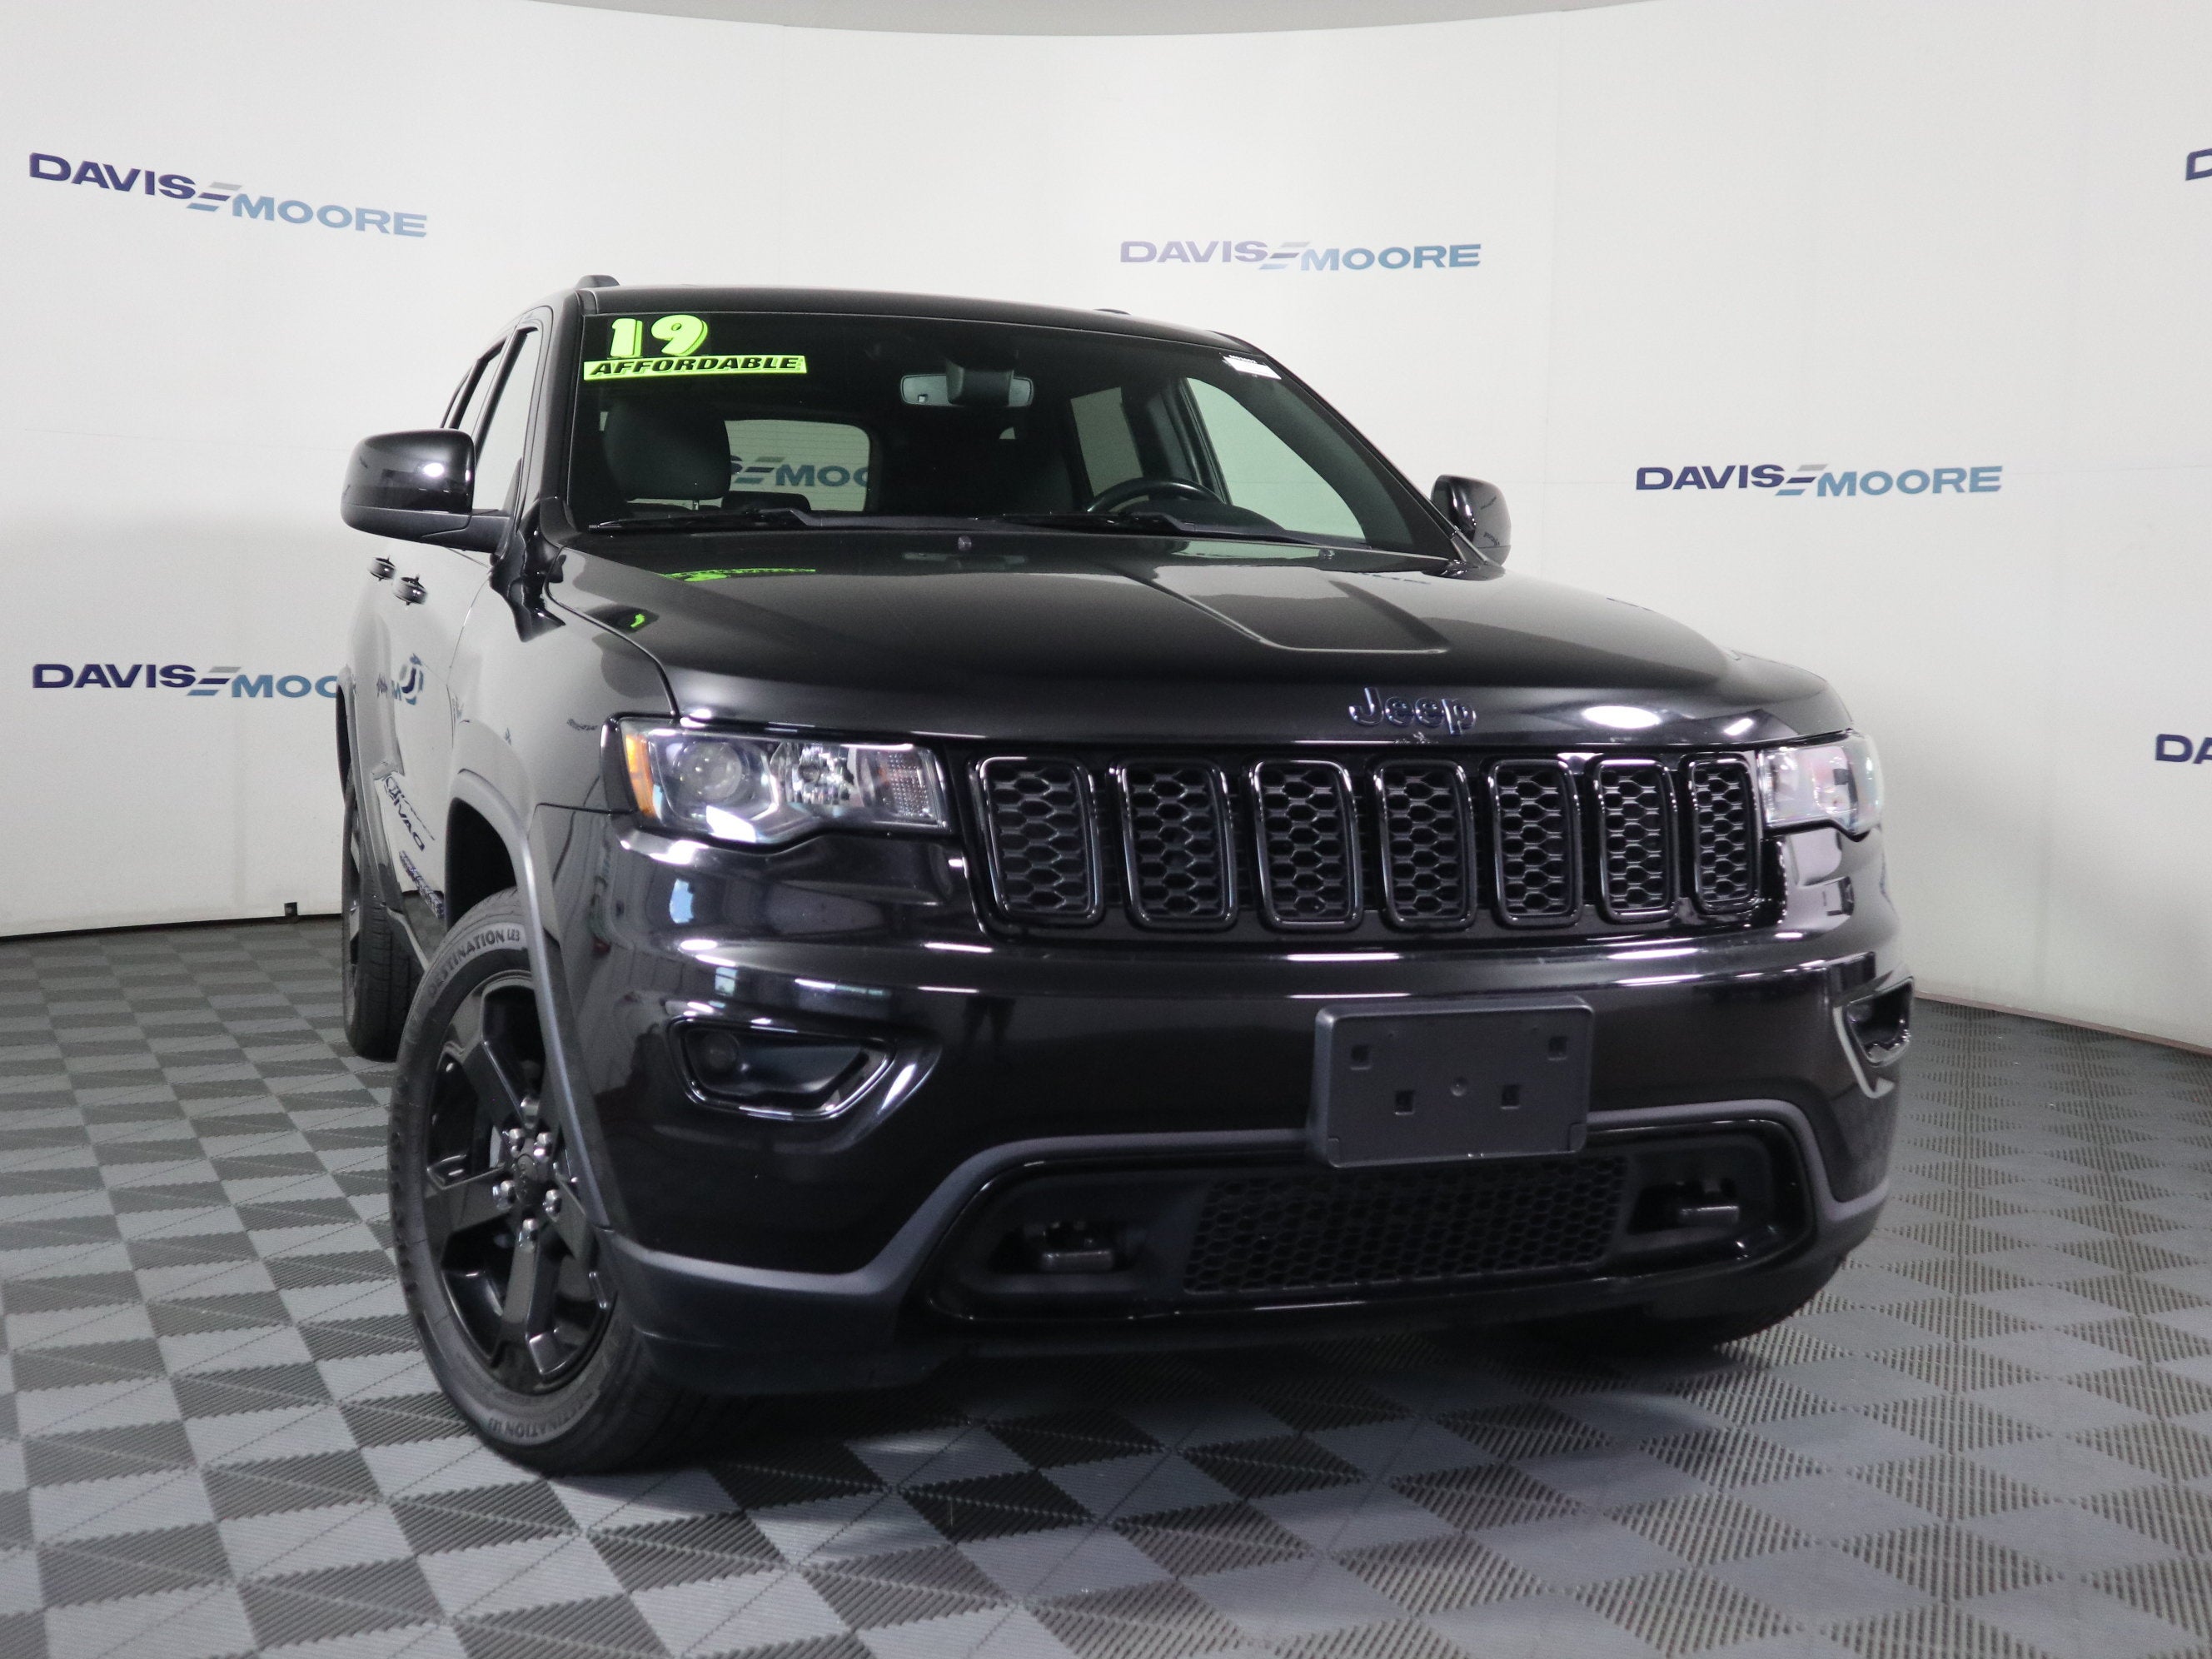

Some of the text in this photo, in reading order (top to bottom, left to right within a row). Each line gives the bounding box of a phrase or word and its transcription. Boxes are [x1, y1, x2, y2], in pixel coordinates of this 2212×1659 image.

[29, 152, 427, 238] DAVIS MOORE
[1119, 240, 1482, 272] DAVIS MOORE
[610, 314, 709, 358] 19
[589, 356, 803, 376] AFFORDABLE
[1636, 463, 2004, 497] DAVIS MOORE
[32, 663, 337, 699] DAVIS MOO
[1348, 686, 1477, 735] Jeep
